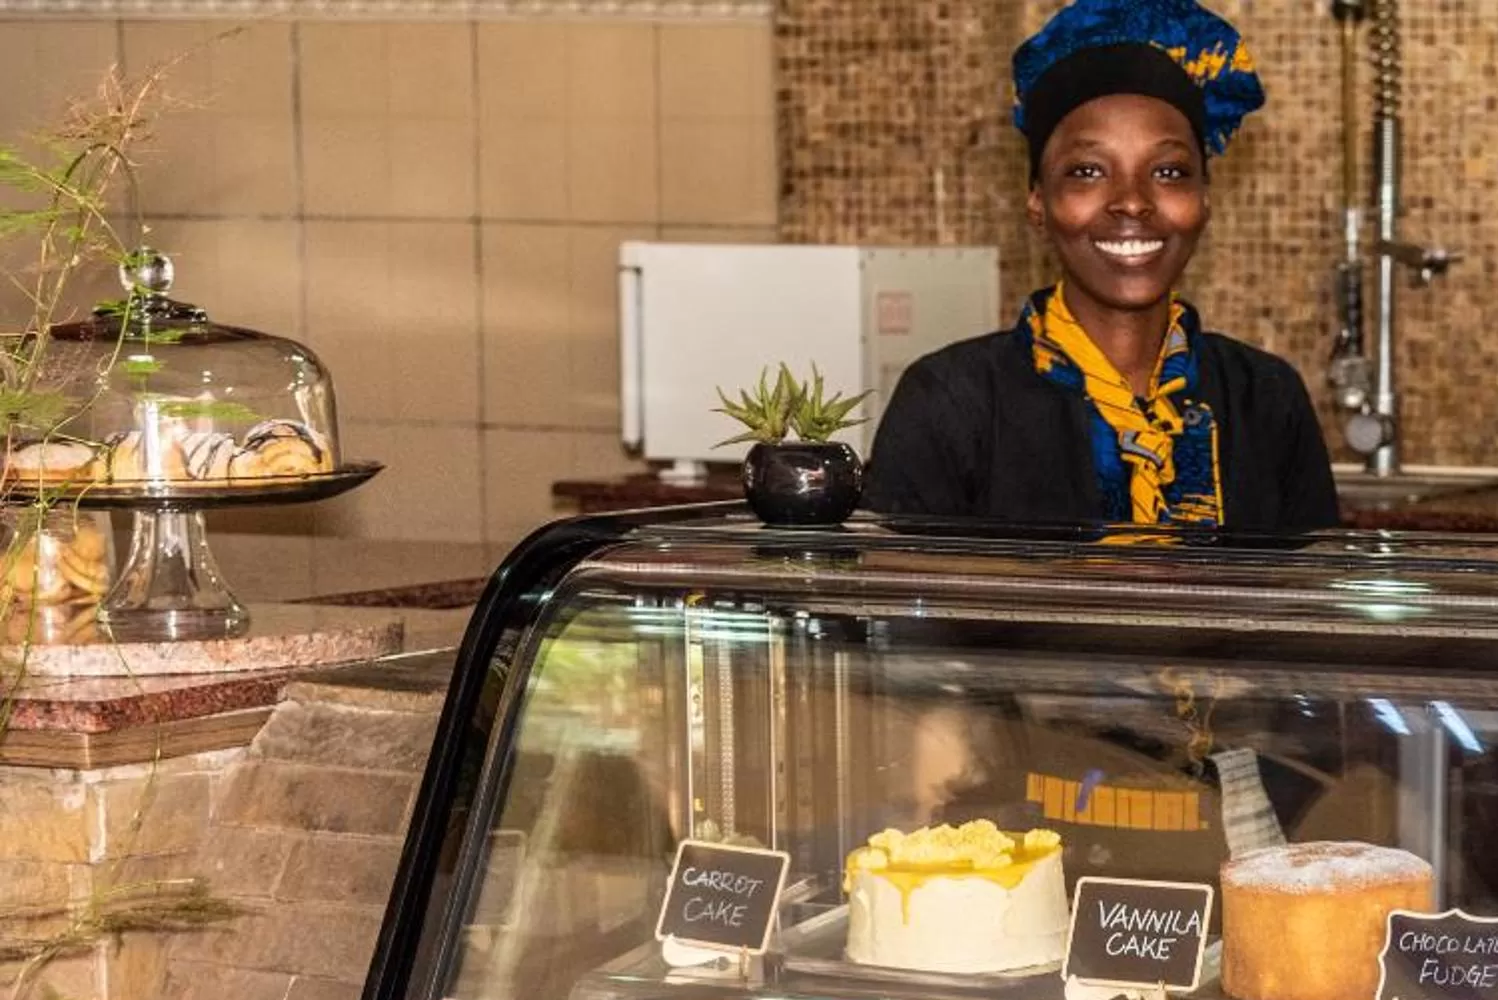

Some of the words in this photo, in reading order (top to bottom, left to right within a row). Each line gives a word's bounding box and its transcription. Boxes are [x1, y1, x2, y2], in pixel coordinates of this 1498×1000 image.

[683, 868, 763, 897] CARROT
[684, 897, 748, 926] CAKE
[1099, 900, 1202, 937] VANNILA
[1106, 932, 1177, 960] CAKE
